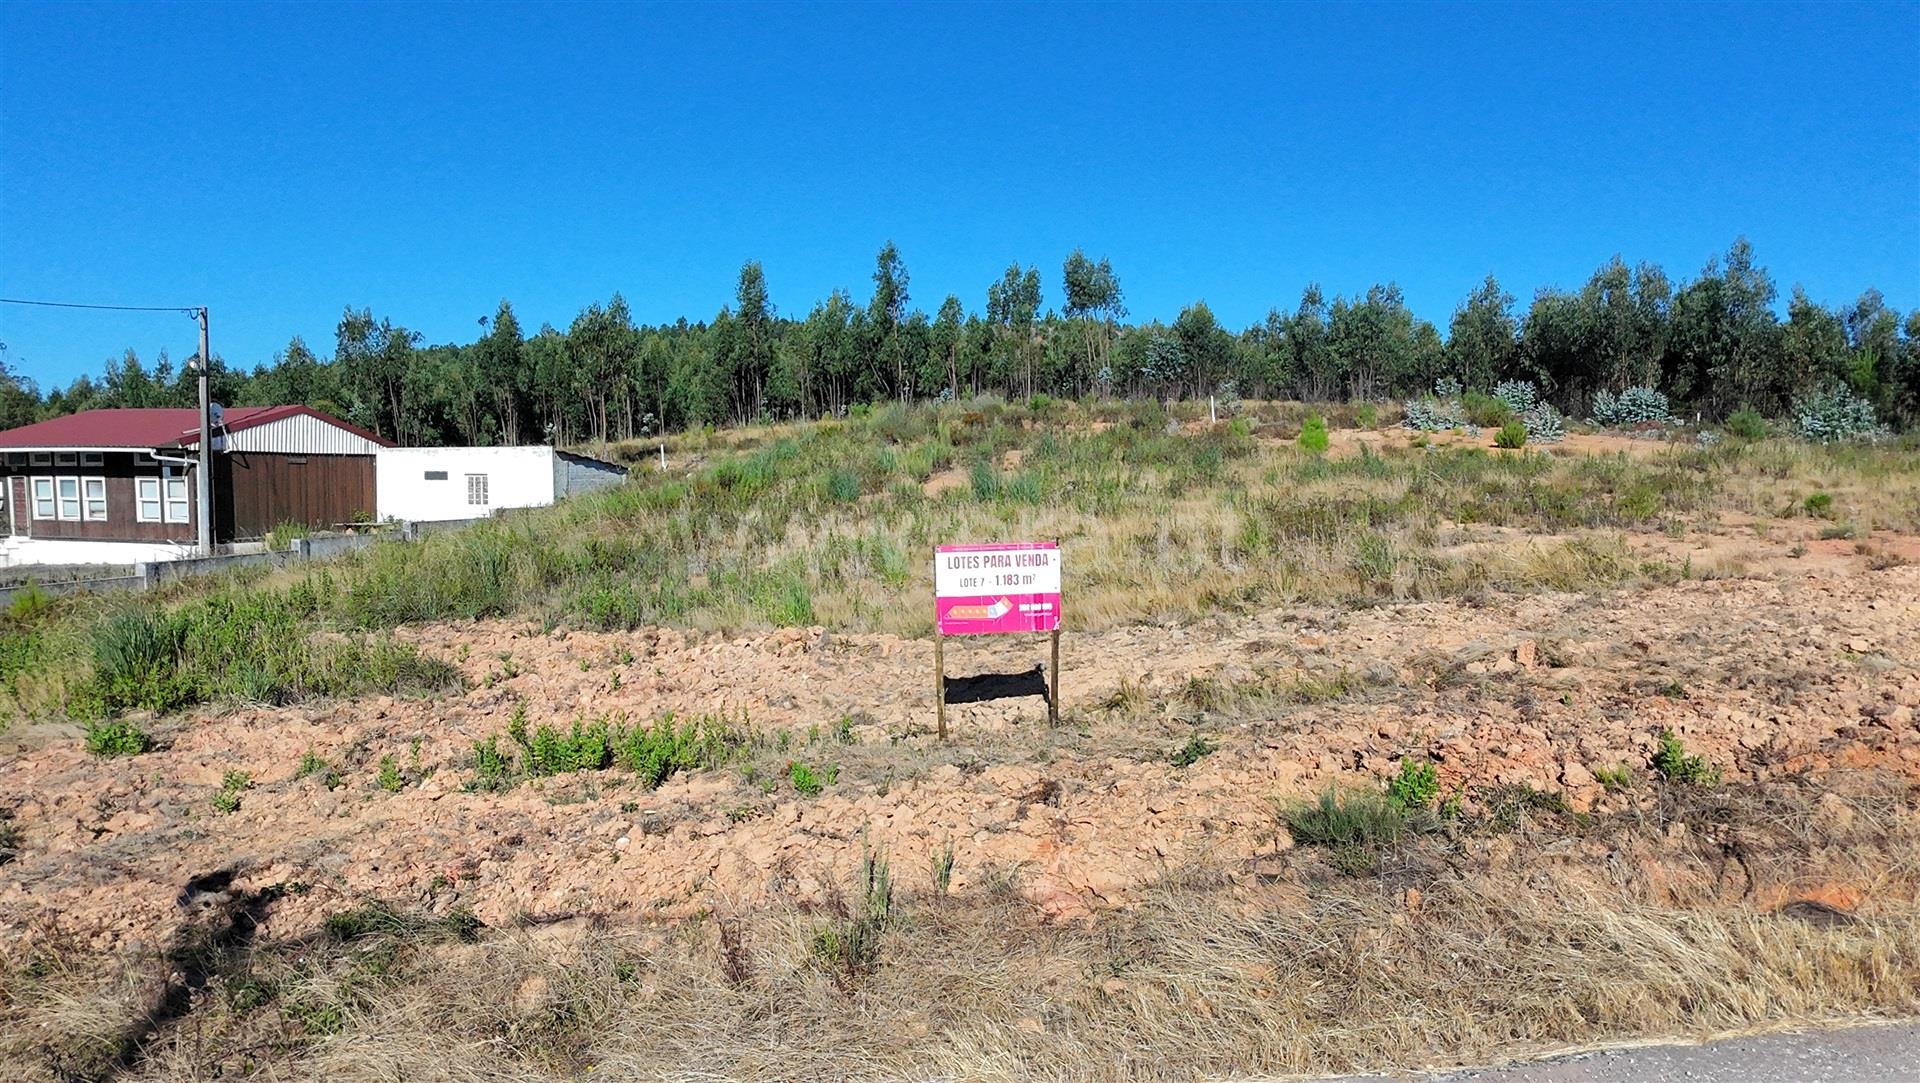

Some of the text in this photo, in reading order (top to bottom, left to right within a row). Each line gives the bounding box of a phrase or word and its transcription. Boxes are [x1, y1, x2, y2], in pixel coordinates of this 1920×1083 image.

[947, 553, 1049, 570] LOTES PARA VENDA
[959, 577, 978, 588] LOTE
[995, 573, 1020, 587] 1.183
